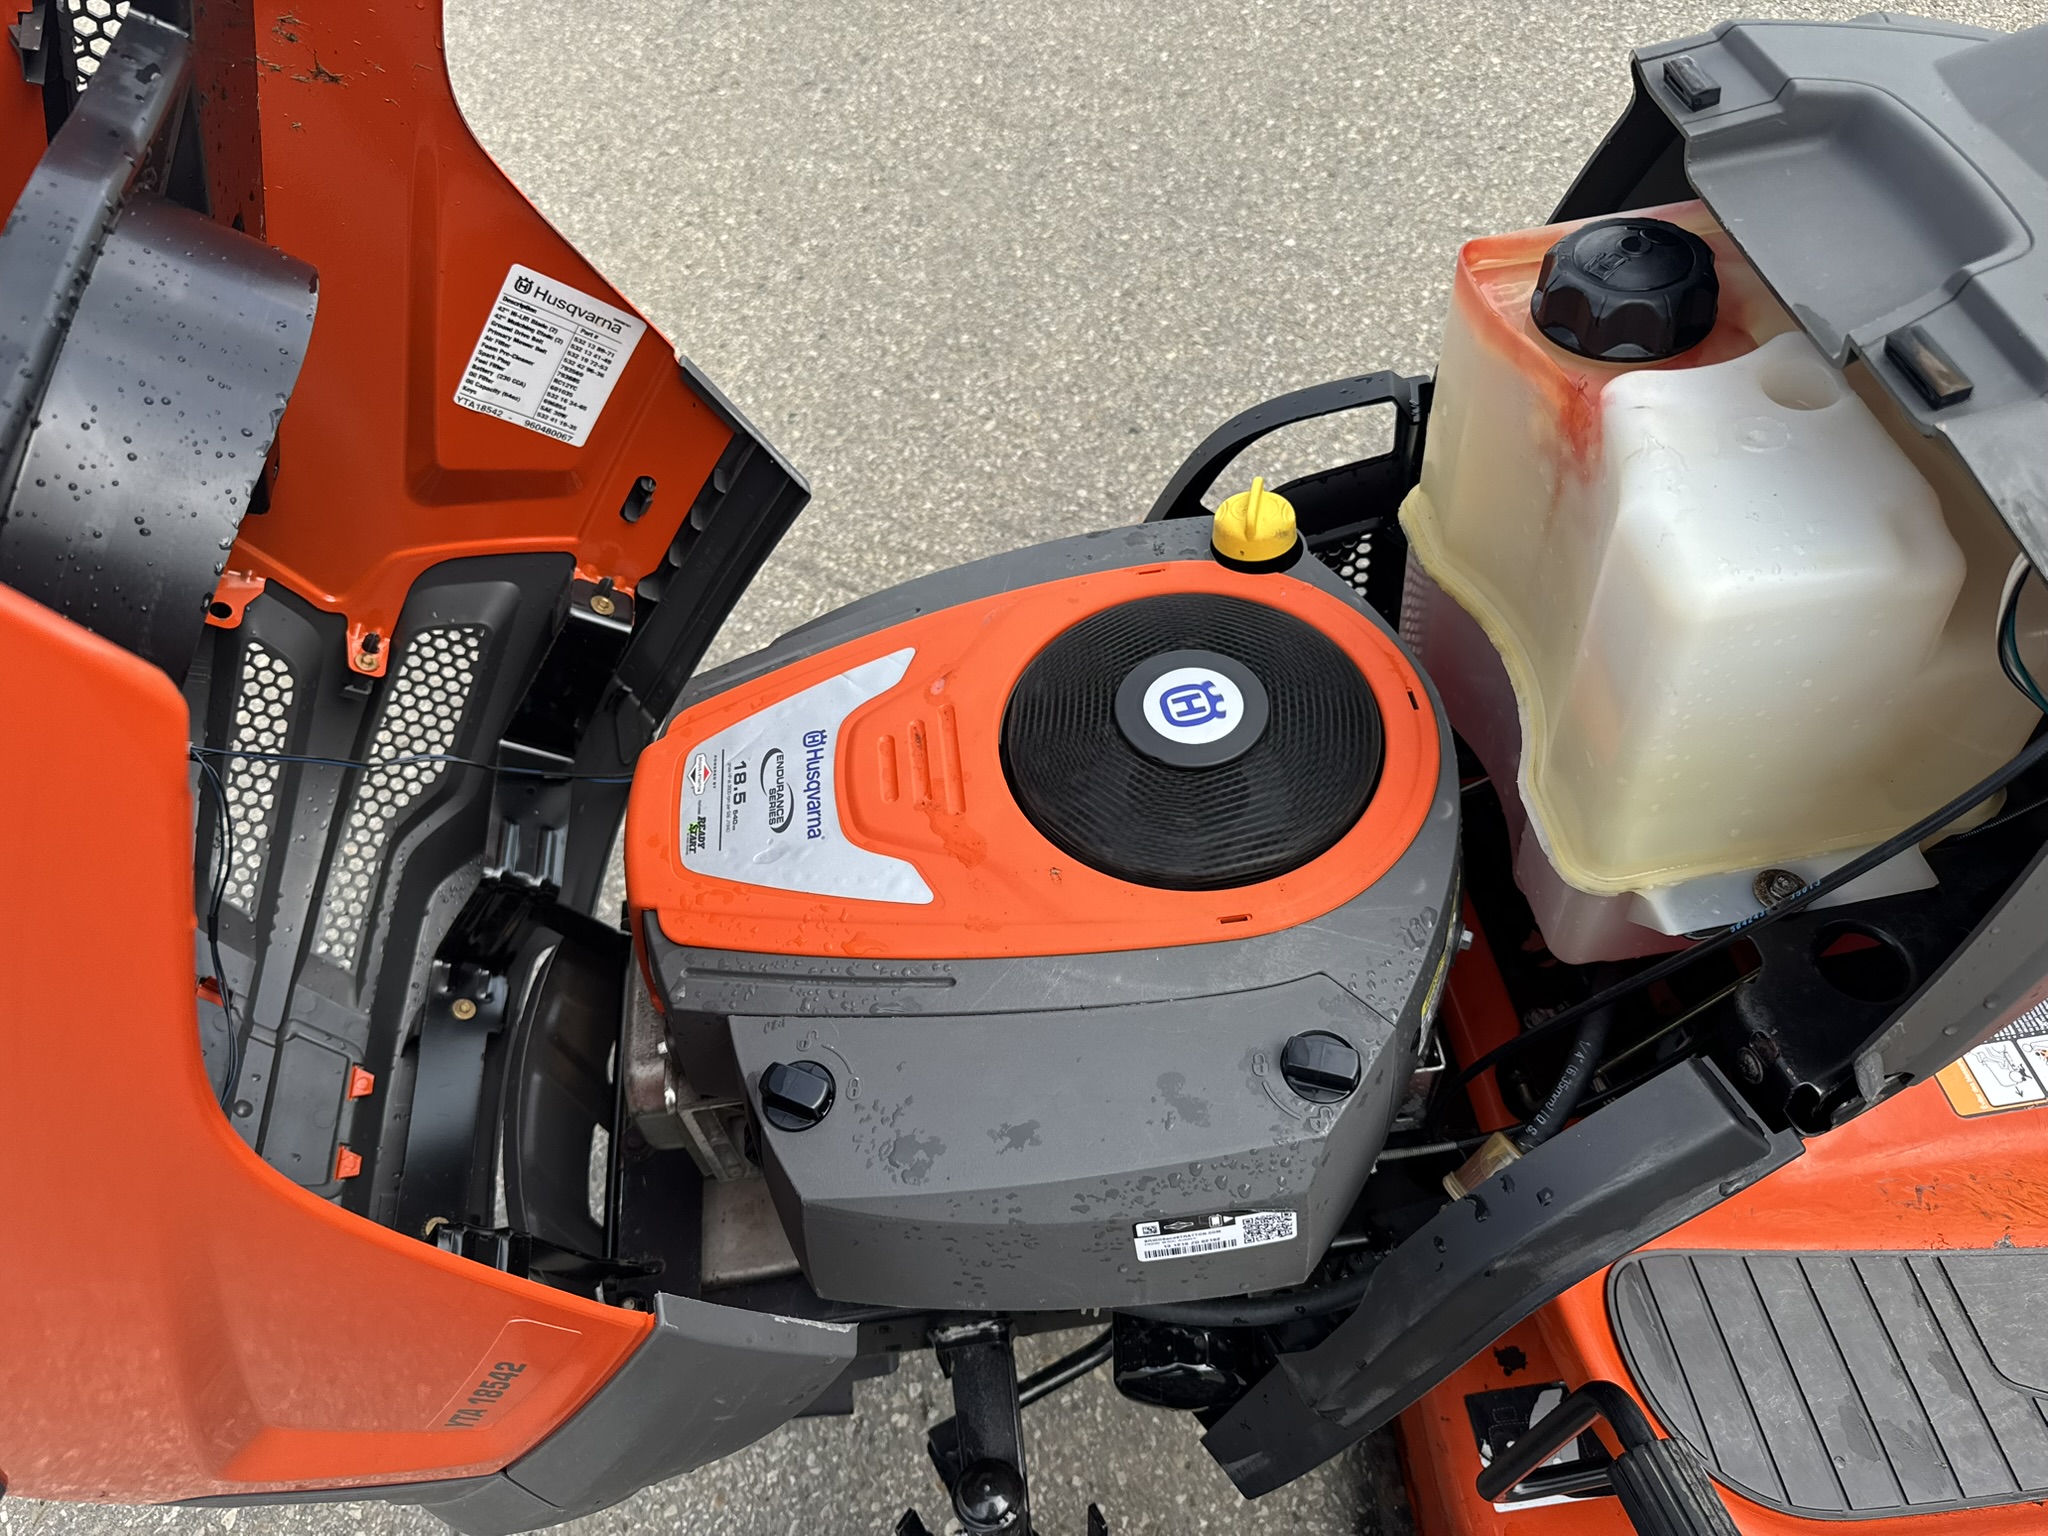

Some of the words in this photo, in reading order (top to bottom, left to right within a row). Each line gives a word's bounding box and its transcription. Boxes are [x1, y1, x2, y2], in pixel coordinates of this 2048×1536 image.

[502, 295, 537, 313] Description
[533, 286, 622, 334] Husqvarna
[490, 320, 513, 332] Ground
[513, 329, 530, 339] Drive
[530, 335, 543, 344] Belt
[530, 318, 548, 329] Blade
[548, 326, 558, 334] (2)
[579, 328, 593, 337] Part
[483, 334, 493, 342] Air
[494, 338, 511, 348] Filter
[487, 327, 511, 341] Primary
[512, 337, 534, 349] Mower
[534, 345, 547, 354] Belt
[553, 336, 563, 345] (2)
[569, 343, 582, 352] 532
[573, 336, 586, 345] 532
[477, 349, 496, 360] Spark
[496, 356, 511, 366] Plug
[480, 341, 498, 352] Foam
[499, 348, 535, 366] Pre-Cleaner
[566, 350, 579, 359] 532
[474, 356, 488, 365] Fuel
[488, 361, 505, 372] Filter
[563, 357, 575, 366] 532
[576, 362, 585, 370] 42
[471, 363, 494, 376] Battery
[496, 372, 511, 383] (230
[511, 378, 526, 388] CCA)
[477, 374, 494, 384] Filter
[461, 385, 477, 395] Keys
[474, 381, 501, 396] Capacity
[546, 391, 558, 400] 532
[536, 411, 549, 420] 532
[539, 405, 552, 413] SAE
[457, 396, 503, 417] YTA18542
[523, 418, 573, 443] 960480067
[732, 760, 747, 805] 18.5
[774, 753, 785, 823] ENDURANCE
[802, 747, 826, 839] Husqvarna
[767, 787, 776, 825] SERIES
[687, 823, 698, 853] START
[696, 816, 706, 848] READY
[1543, 1064, 1579, 1111] (6.35mm)
[444, 1408, 488, 1427] YTA
[467, 1361, 527, 1404] 18542
